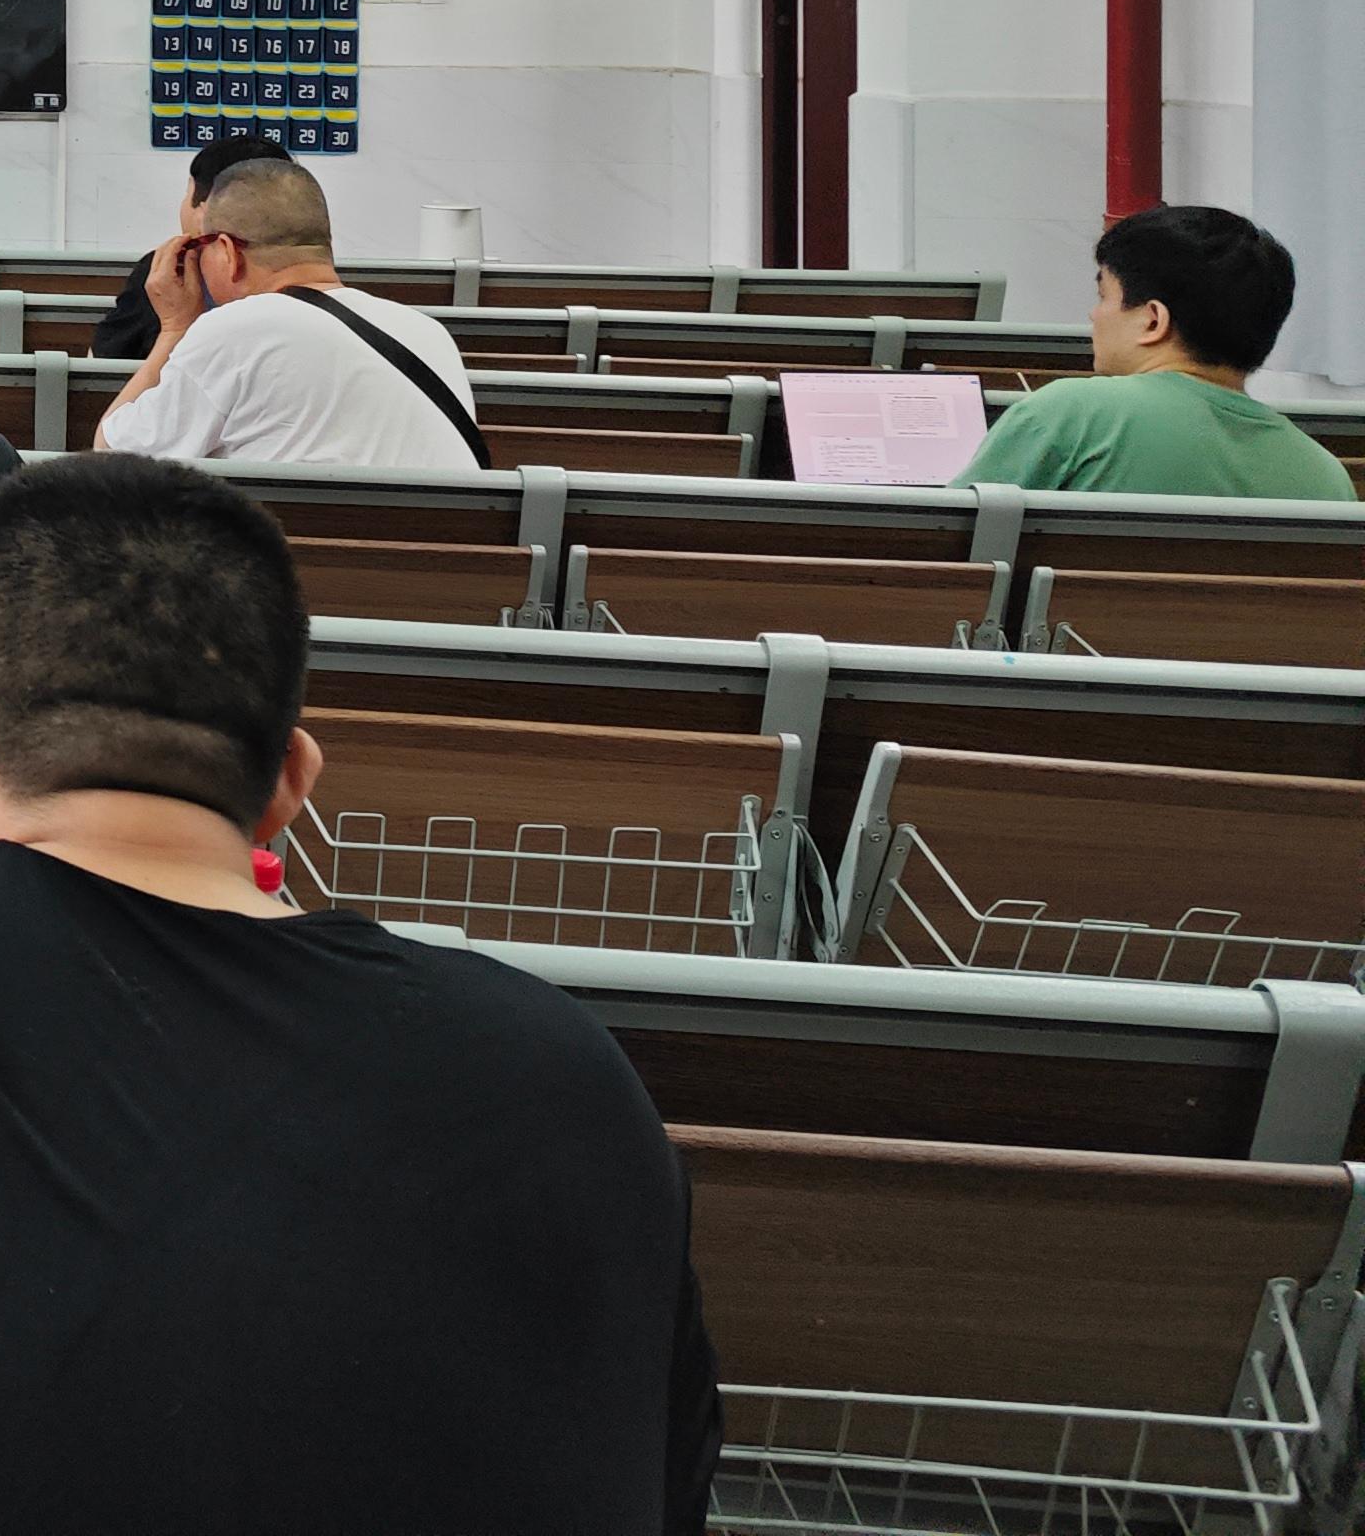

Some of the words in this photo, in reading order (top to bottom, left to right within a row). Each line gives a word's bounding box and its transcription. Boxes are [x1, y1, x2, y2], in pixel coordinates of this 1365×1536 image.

[164, 37, 179, 51] 13
[197, 37, 212, 51] 14
[231, 39, 247, 53] 15
[266, 40, 282, 54] 16
[298, 40, 315, 54] 17
[334, 40, 350, 54] 18
[164, 82, 180, 96] 19
[196, 82, 213, 96] 20
[231, 83, 248, 96] 21
[264, 84, 282, 98] 22
[298, 85, 315, 99] 23
[332, 86, 348, 100] 24
[164, 126, 180, 140] 25
[197, 126, 214, 140] 26
[264, 129, 281, 142] 28
[299, 129, 316, 143] 29
[332, 131, 349, 145] 30
